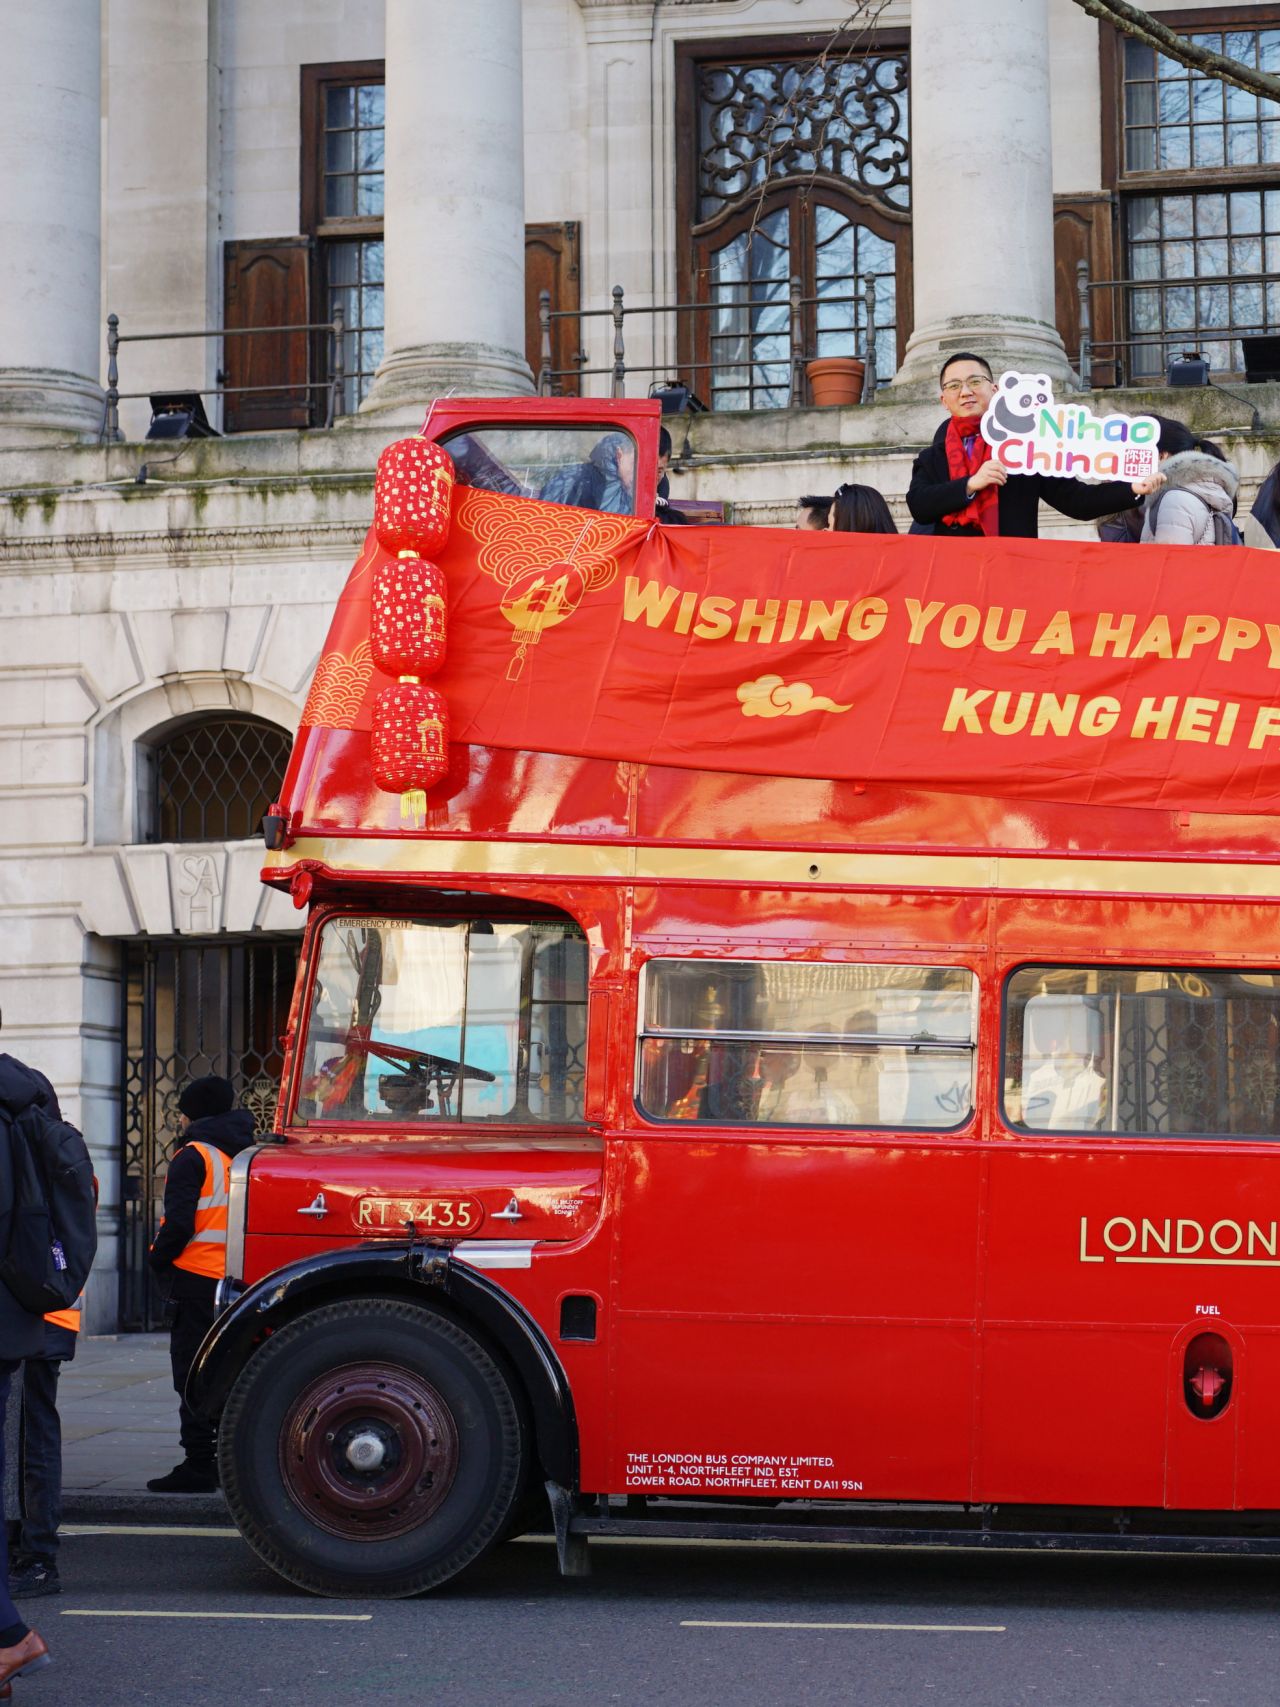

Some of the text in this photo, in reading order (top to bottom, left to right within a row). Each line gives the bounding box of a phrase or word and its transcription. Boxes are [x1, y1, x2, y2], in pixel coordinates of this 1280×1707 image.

[1039, 408, 1155, 443] Nihao
[997, 438, 1119, 475] China
[623, 575, 888, 644] WISHING
[904, 597, 1025, 653] YOU
[1030, 610, 1075, 655] A
[941, 687, 1122, 738] KUNG
[1130, 695, 1241, 746] HEI
[339, 919, 410, 929] EMERGENCY EXIT
[358, 1200, 472, 1227] RT 3435
[1079, 1216, 1278, 1263] LONDON
[1195, 1305, 1221, 1315] FUEL
[626, 1465, 653, 1474] UNIT
[680, 1465, 751, 1477] NORTHFLEET
[627, 1453, 649, 1463] THE
[652, 1454, 702, 1464] LONDON
[705, 1455, 727, 1464] BUS
[731, 1455, 788, 1466] COMPANY
[626, 1476, 665, 1486] LOWER
[781, 1479, 811, 1489] KENT
